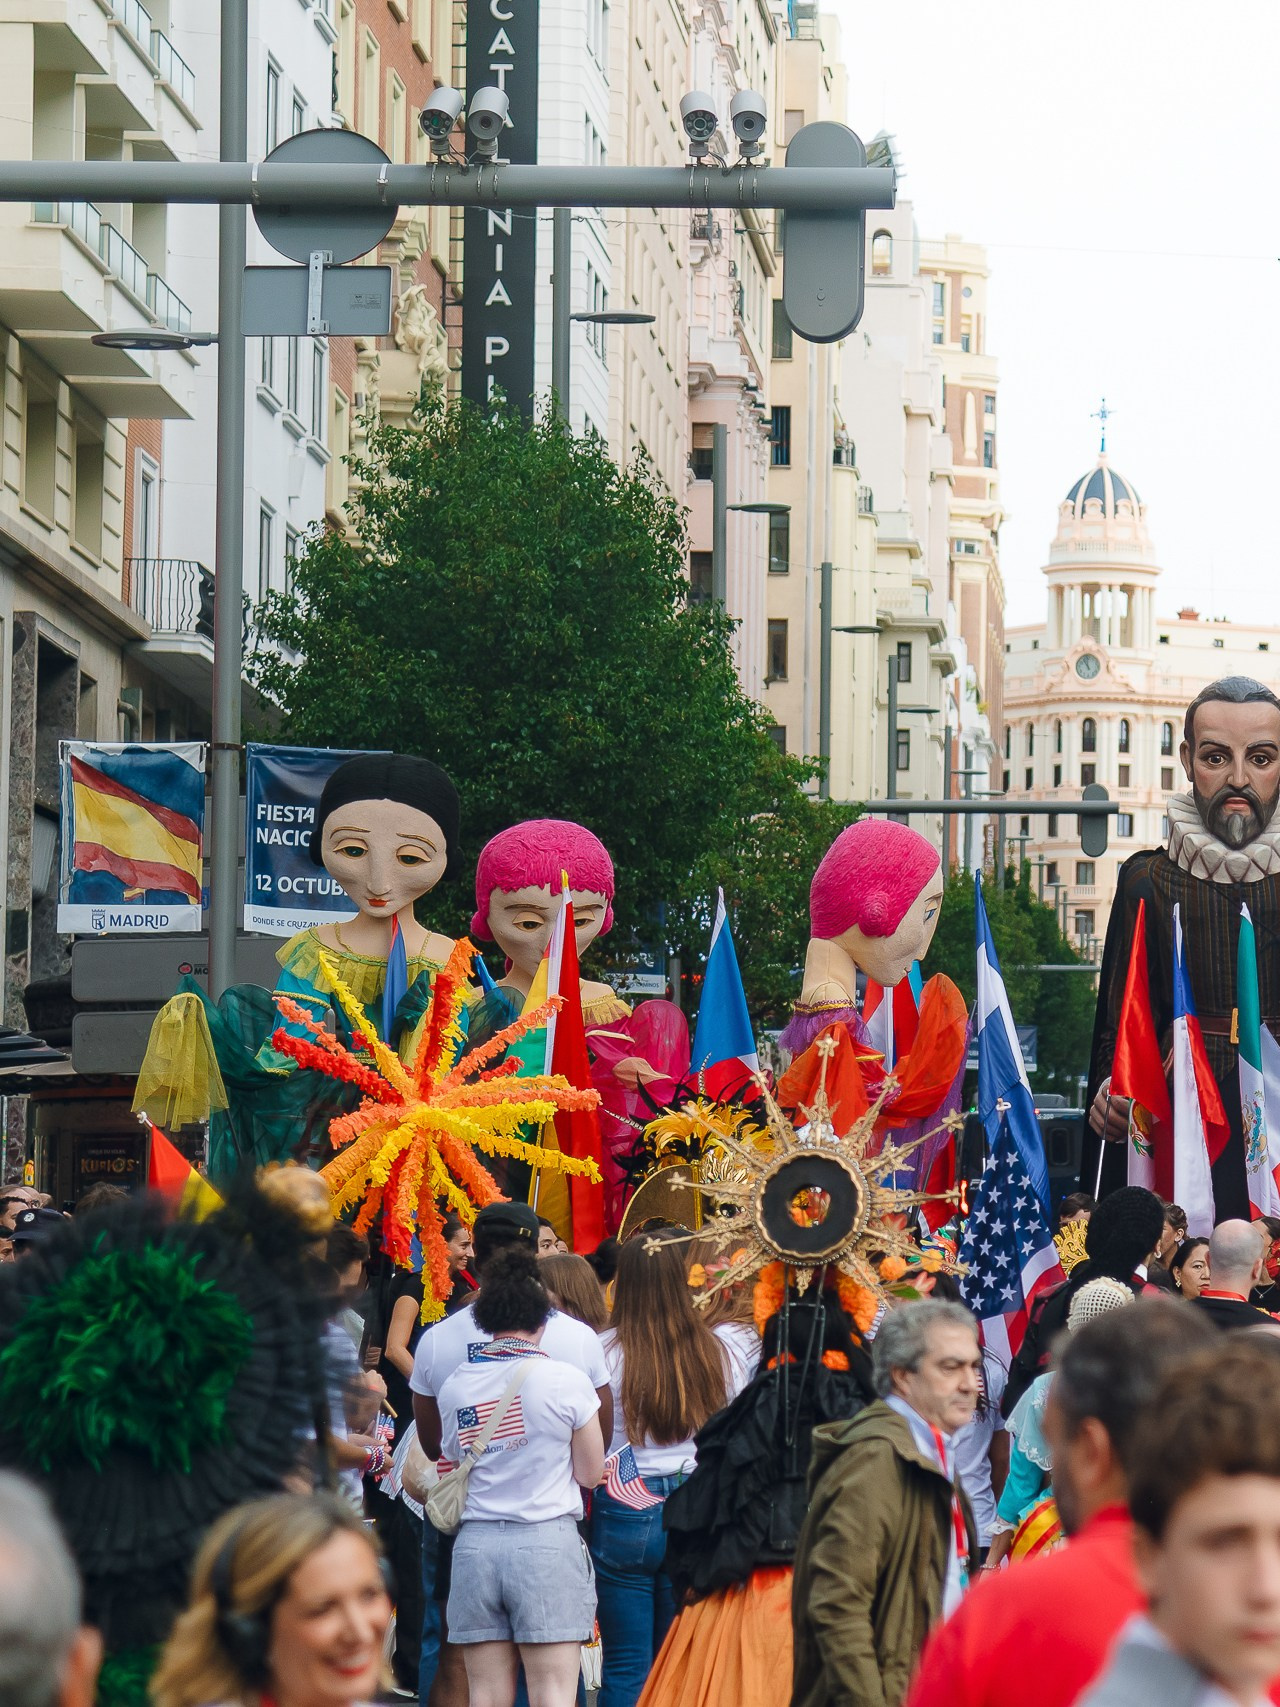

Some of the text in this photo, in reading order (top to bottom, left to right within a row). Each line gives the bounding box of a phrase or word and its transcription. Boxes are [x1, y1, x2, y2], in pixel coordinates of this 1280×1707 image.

[485, 0, 515, 306] CATLNIA
[257, 804, 316, 824] FIESTA
[256, 827, 313, 848] NACIO
[255, 874, 349, 897] 12 OCTUB
[109, 914, 169, 930] MADRID
[252, 916, 275, 926] DONDE
[287, 920, 319, 930] CRUZAN
[194, 967, 208, 975] MO
[505, 1437, 528, 1452] 250
